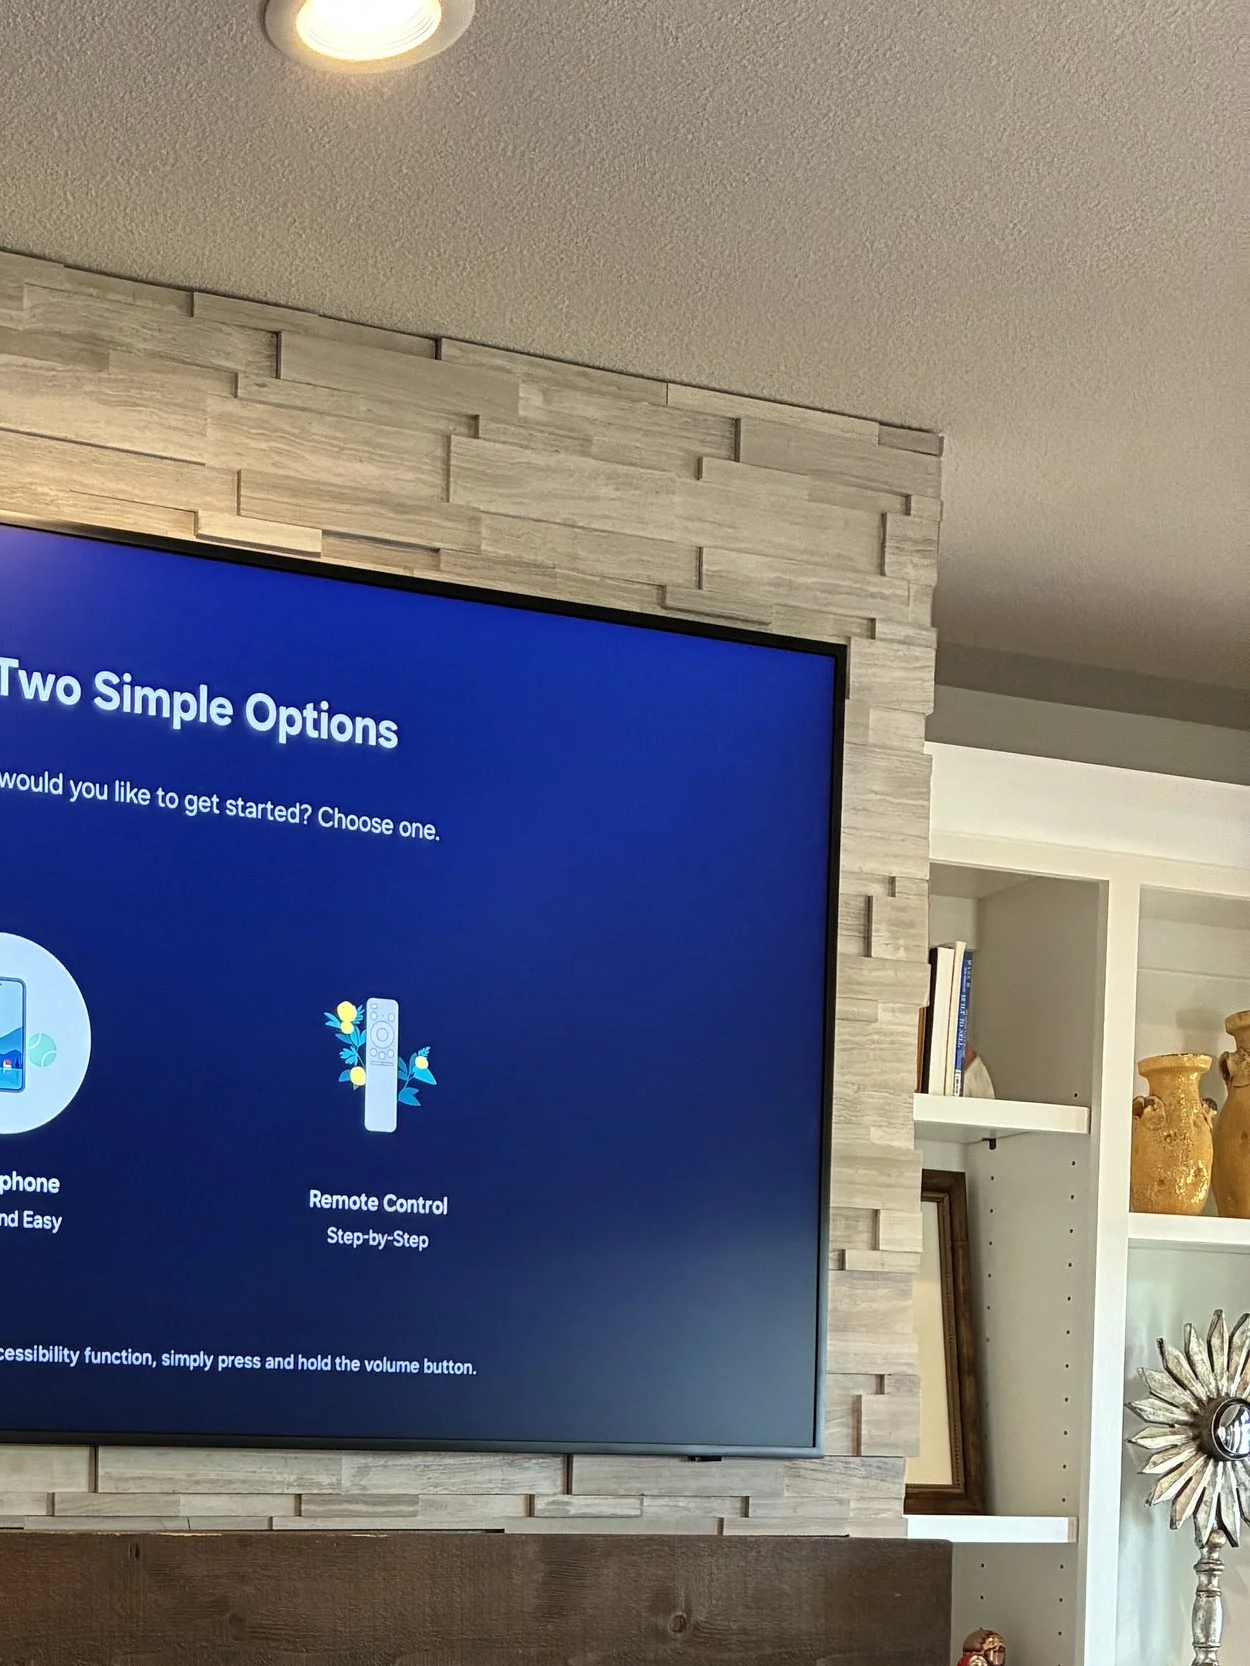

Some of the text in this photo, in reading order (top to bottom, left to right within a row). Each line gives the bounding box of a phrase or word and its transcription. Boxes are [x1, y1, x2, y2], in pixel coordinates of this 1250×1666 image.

[93, 670, 234, 730] Simple
[245, 692, 399, 749] Options
[69, 779, 108, 803] you
[114, 779, 151, 806] like
[155, 787, 179, 809] to
[184, 793, 220, 817] get
[225, 796, 313, 825] started?
[317, 806, 394, 835] Choose
[398, 820, 440, 841] one.
[309, 1189, 448, 1216] Remote Control
[22, 1209, 63, 1234] Easy
[326, 1226, 429, 1252] Step-by-Step
[83, 1346, 157, 1369] function,
[161, 1349, 214, 1372] simply
[217, 1355, 262, 1372] press
[264, 1353, 295, 1370] and
[297, 1353, 332, 1371] hold
[334, 1355, 361, 1372] the
[364, 1356, 420, 1374] volume
[423, 1357, 477, 1376] button.
